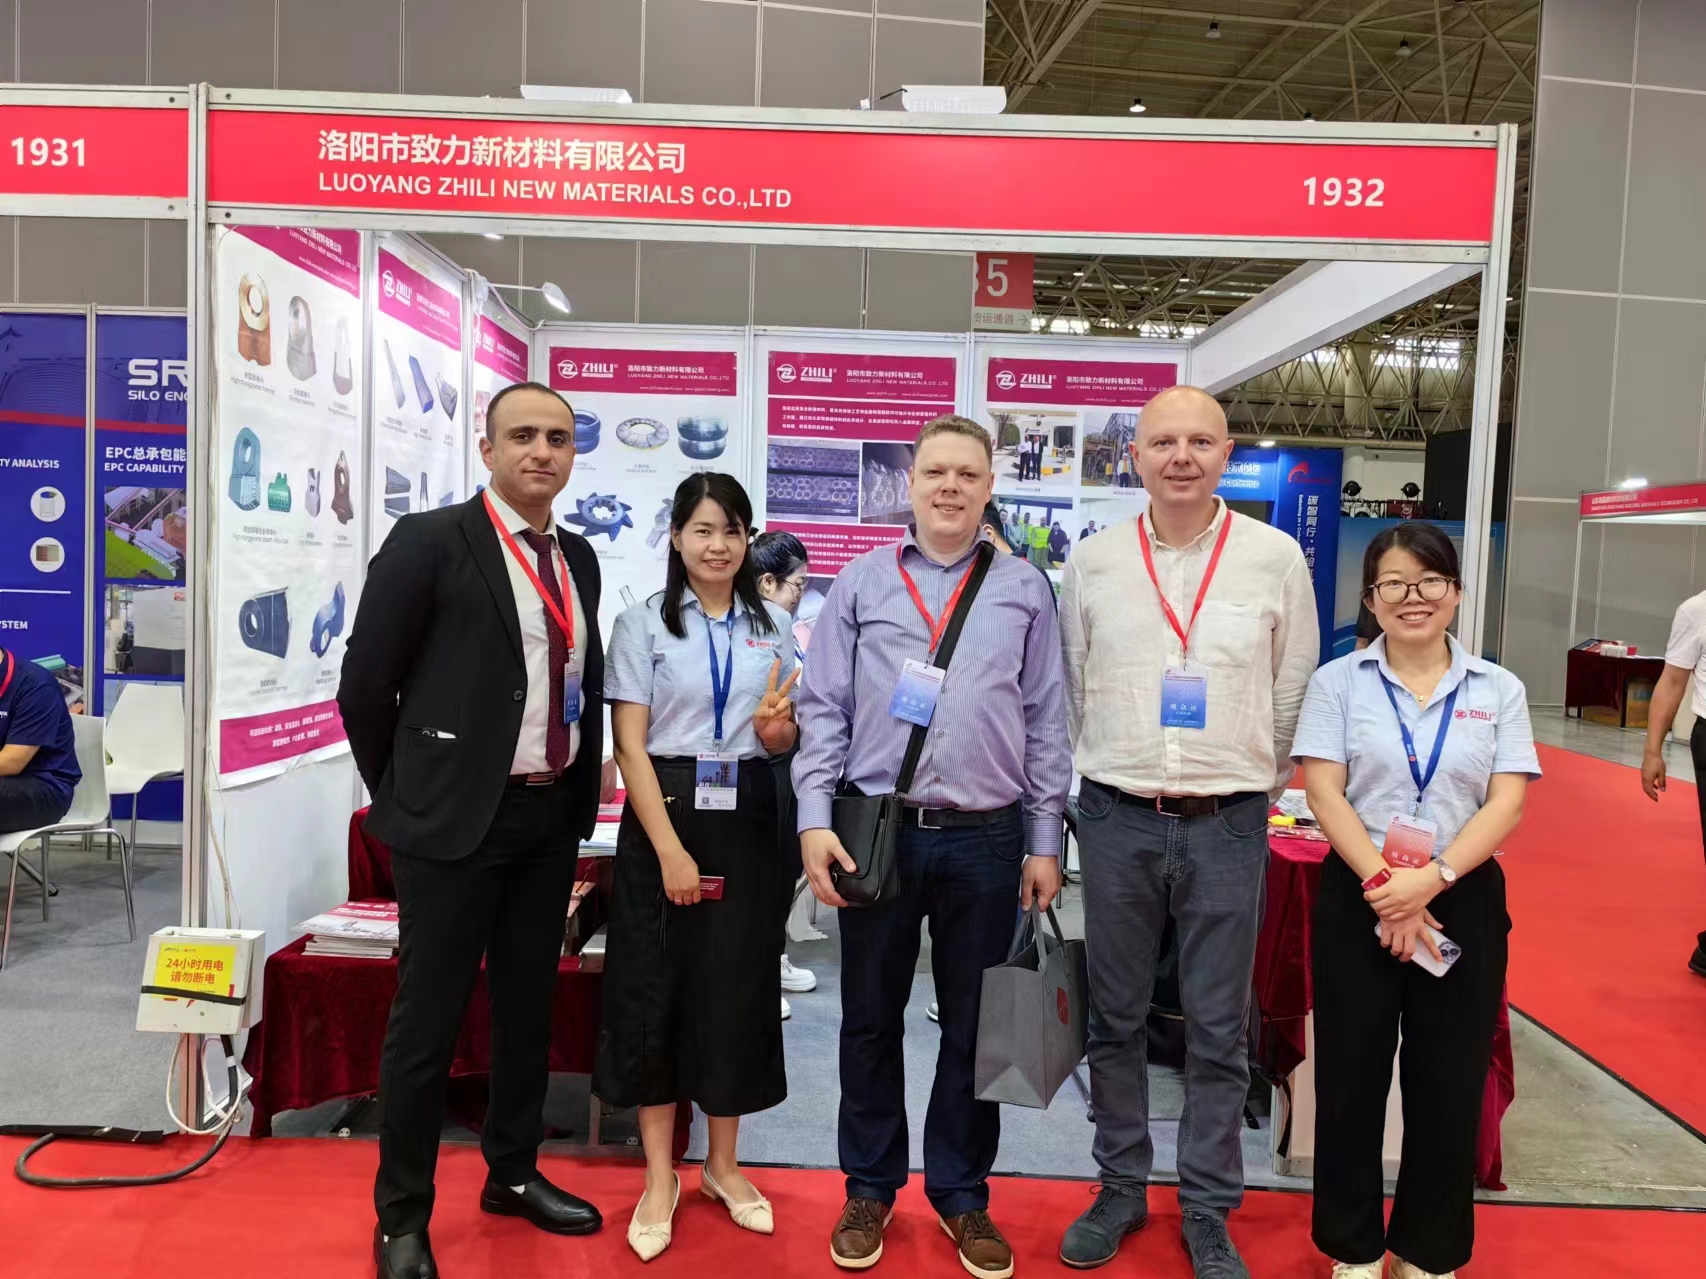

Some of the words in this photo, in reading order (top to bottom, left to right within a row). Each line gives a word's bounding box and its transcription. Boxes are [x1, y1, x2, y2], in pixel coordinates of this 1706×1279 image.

[11, 137, 85, 166] 1931
[318, 129, 686, 174] 洛阳市致力新材料有限公司
[319, 172, 431, 195] LUOYANG
[438, 177, 495, 197] ZHILI
[503, 179, 556, 200] NEW
[563, 181, 695, 205] MATERIALS
[702, 186, 792, 210] CO.,LTD
[1303, 176, 1385, 207] 1932
[975, 258, 1008, 297] 5
[581, 362, 614, 373] ZHILI
[627, 364, 705, 374] 洛阳市致力新材料有限公司
[800, 366, 833, 378] ZHILI
[846, 369, 924, 380] 洛阳市致力新材料有限公司
[1020, 373, 1053, 384] ZHILI
[1066, 375, 1144, 386] 洛阳市致力新材料有限公司
[128, 389, 160, 401] SILO
[12, 459, 60, 469] ANALYSIS
[104, 462, 124, 472] EPC
[126, 463, 184, 474] CAPABILITY
[166, 957, 224, 972] 24小时用电
[170, 970, 216, 985] 请勿断电
